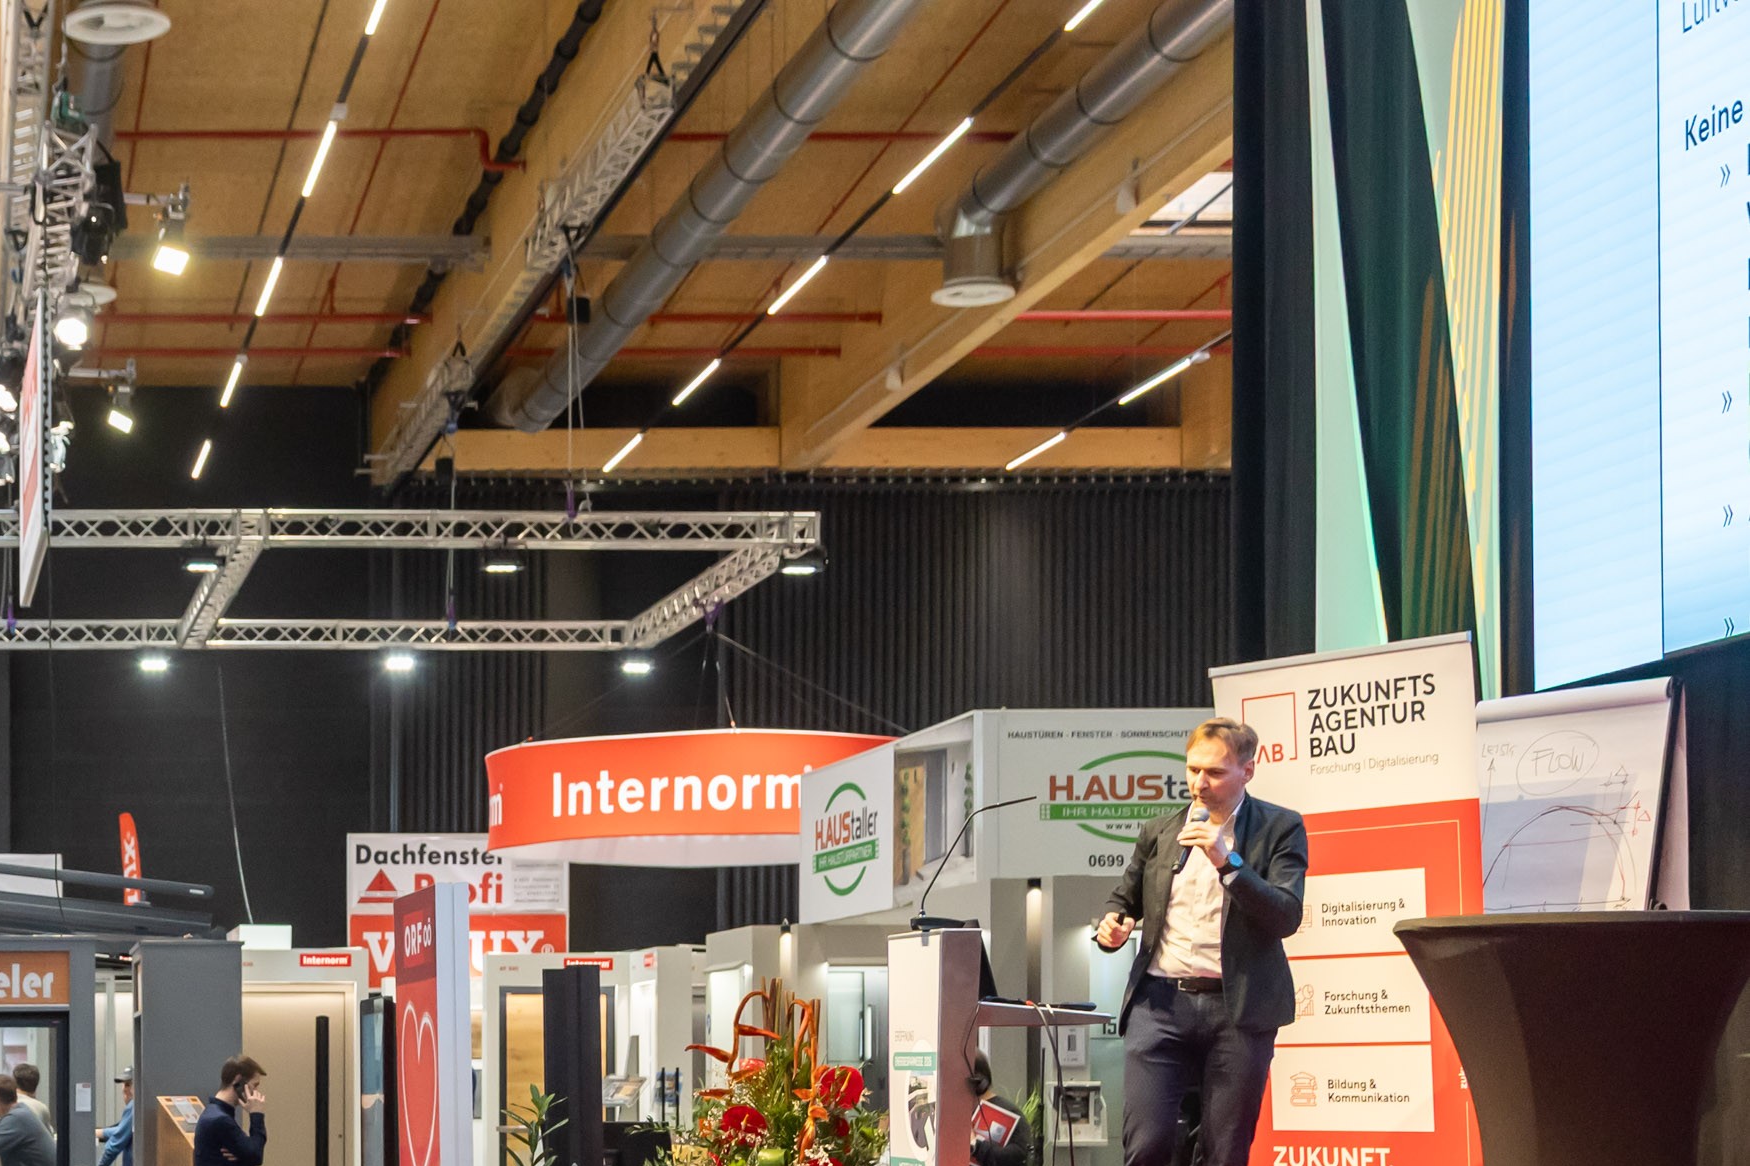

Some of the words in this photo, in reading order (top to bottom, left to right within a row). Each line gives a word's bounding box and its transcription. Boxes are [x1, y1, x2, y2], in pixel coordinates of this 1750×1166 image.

[1685, 99, 1743, 152] Keine
[1307, 673, 1436, 711] ZUKUNFTS
[1309, 700, 1426, 735] AGENTUR
[1008, 730, 1064, 739] HAUSTÜREN
[1071, 731, 1113, 739] FENSTER
[1256, 743, 1284, 765] AB
[1309, 732, 1356, 759] BAU
[1310, 760, 1361, 776] Forschung
[1368, 752, 1439, 772] Digitalisierung
[552, 770, 802, 817] Internorm
[1050, 775, 1191, 801] H.AUSta
[1063, 807, 1087, 817] IHR
[1091, 806, 1186, 817] HAUSTÜRPA
[1088, 854, 1125, 867] 0699
[1321, 900, 1397, 915] Digitalisierung
[1398, 898, 1406, 909] &
[1321, 914, 1377, 927] Innovation
[404, 921, 423, 957] ORF
[302, 955, 349, 965] Internorm
[1324, 990, 1378, 1004] Forschung
[1381, 989, 1388, 1000] &
[1324, 1003, 1411, 1015] Zukunftsthemen
[1328, 1079, 1367, 1091] Bildung
[1369, 1079, 1377, 1090] &
[1328, 1092, 1410, 1103] Kommunikation
